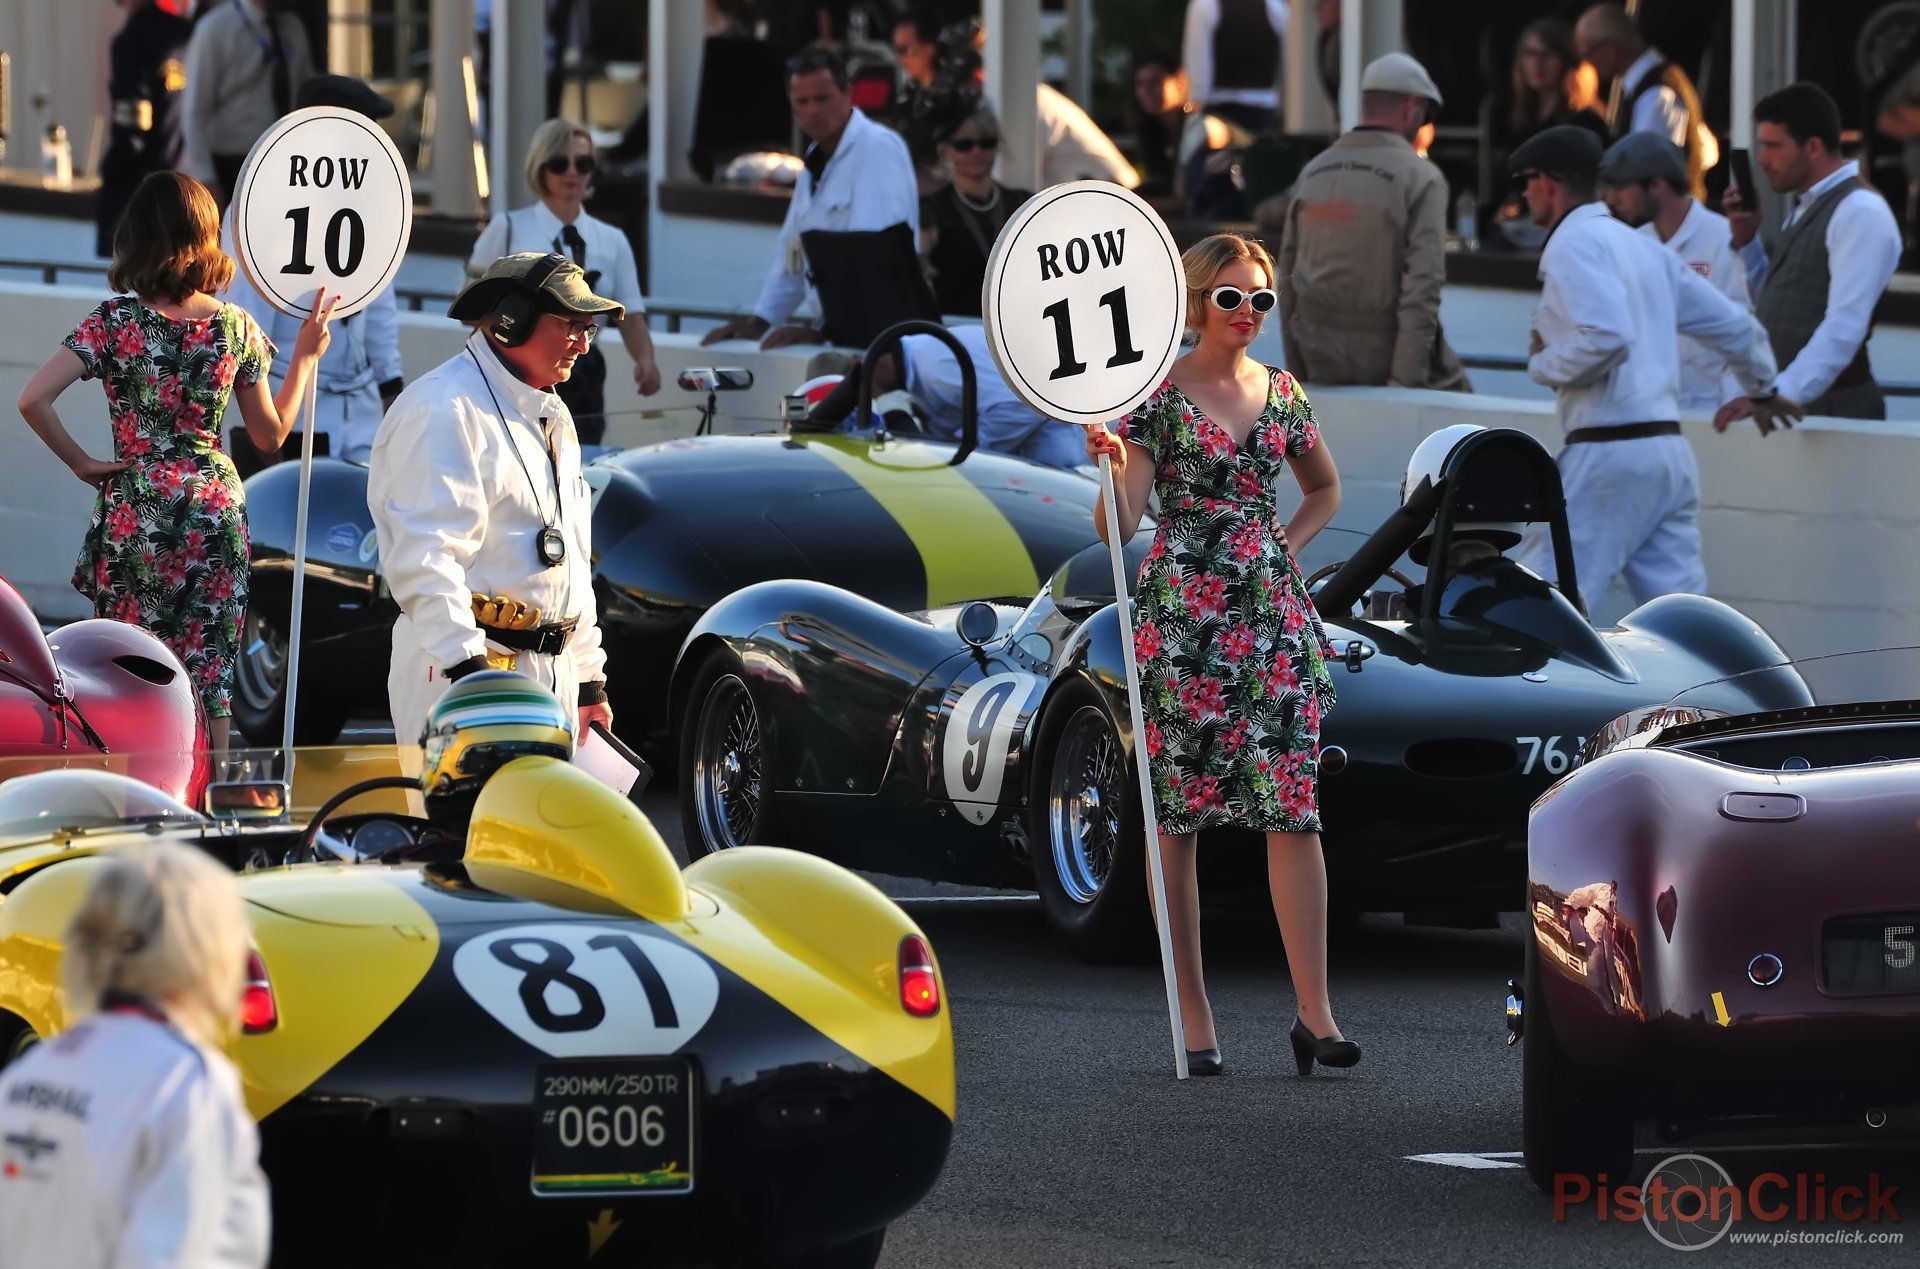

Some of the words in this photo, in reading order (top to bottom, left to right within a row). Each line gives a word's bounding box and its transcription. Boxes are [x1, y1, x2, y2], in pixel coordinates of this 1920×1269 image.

[289, 155, 369, 190] ROW
[280, 206, 365, 278] 10
[1037, 228, 1125, 281] ROW
[1042, 285, 1144, 381] 11
[962, 681, 1017, 793] 9
[488, 934, 679, 1033] 81
